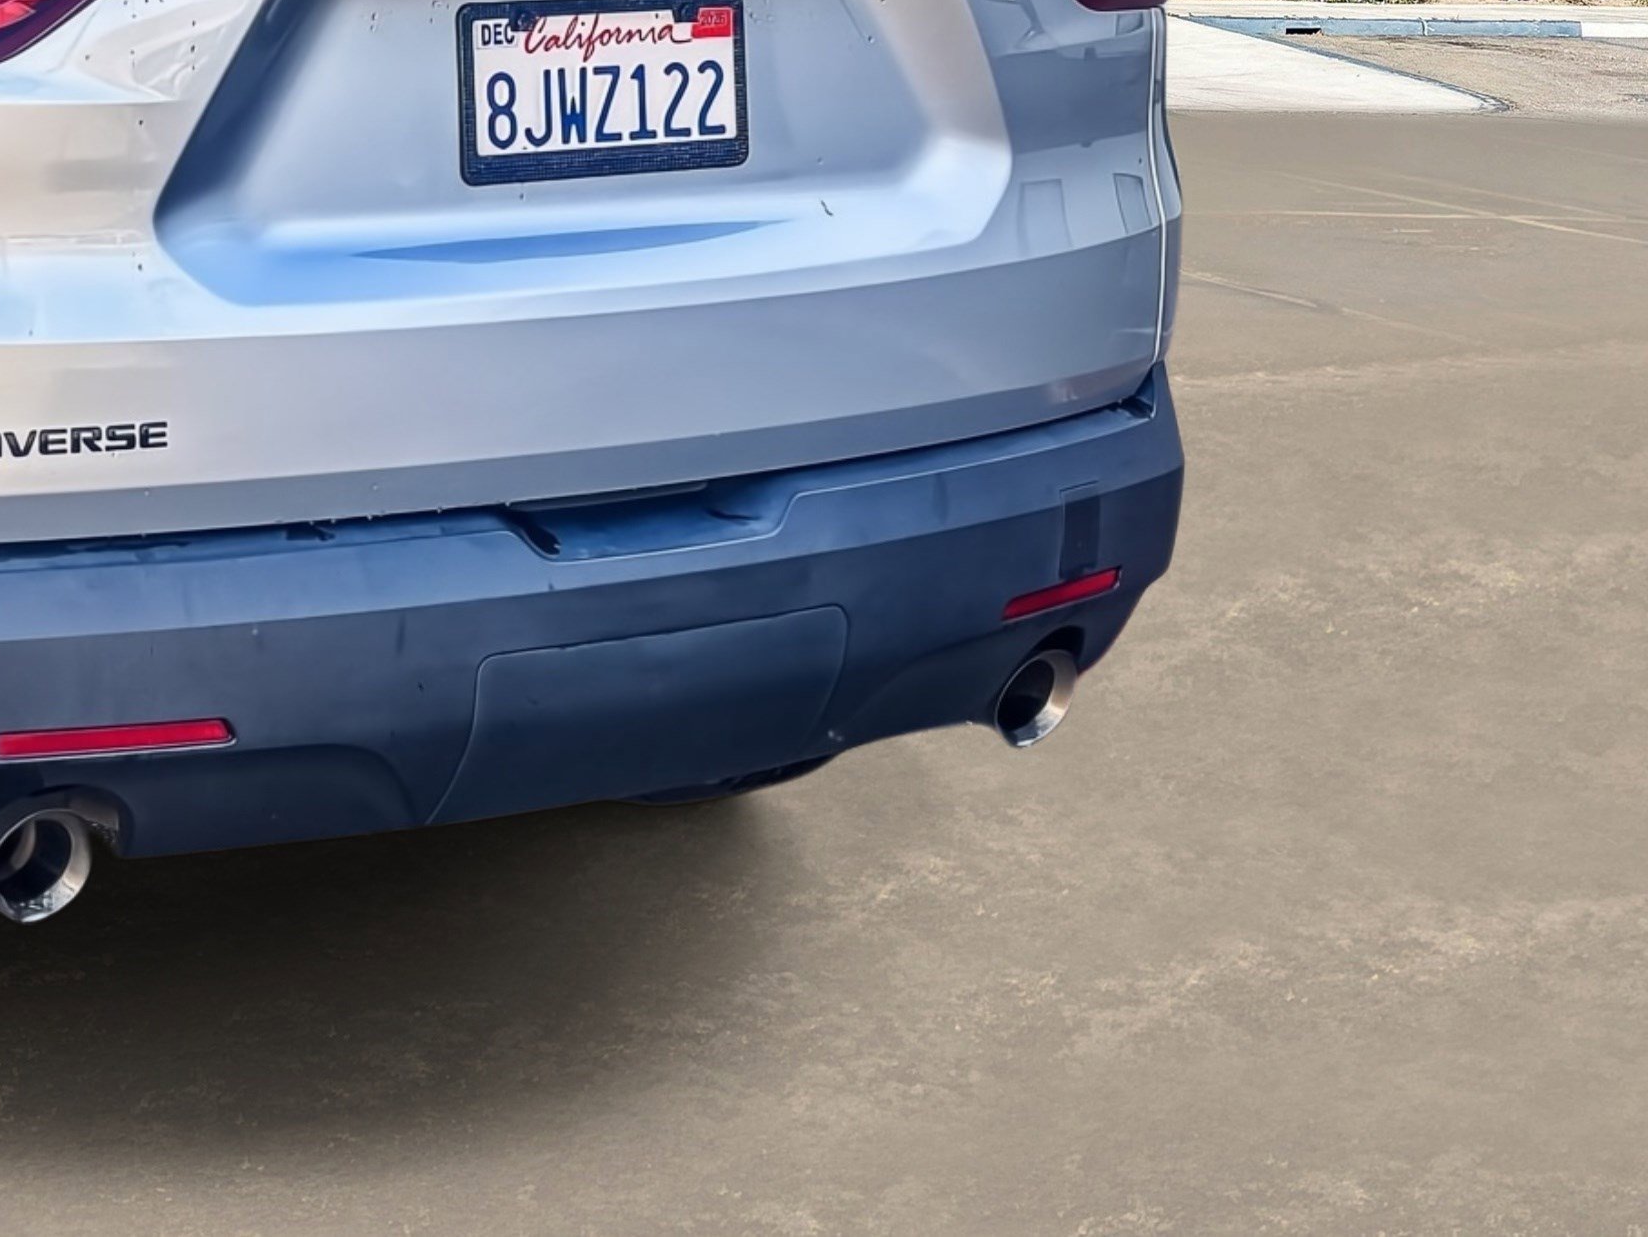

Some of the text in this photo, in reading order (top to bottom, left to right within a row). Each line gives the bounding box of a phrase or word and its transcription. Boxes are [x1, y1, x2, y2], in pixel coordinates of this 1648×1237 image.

[480, 21, 516, 47] DEC
[523, 13, 693, 63] California
[486, 59, 727, 151] 8JWZ122
